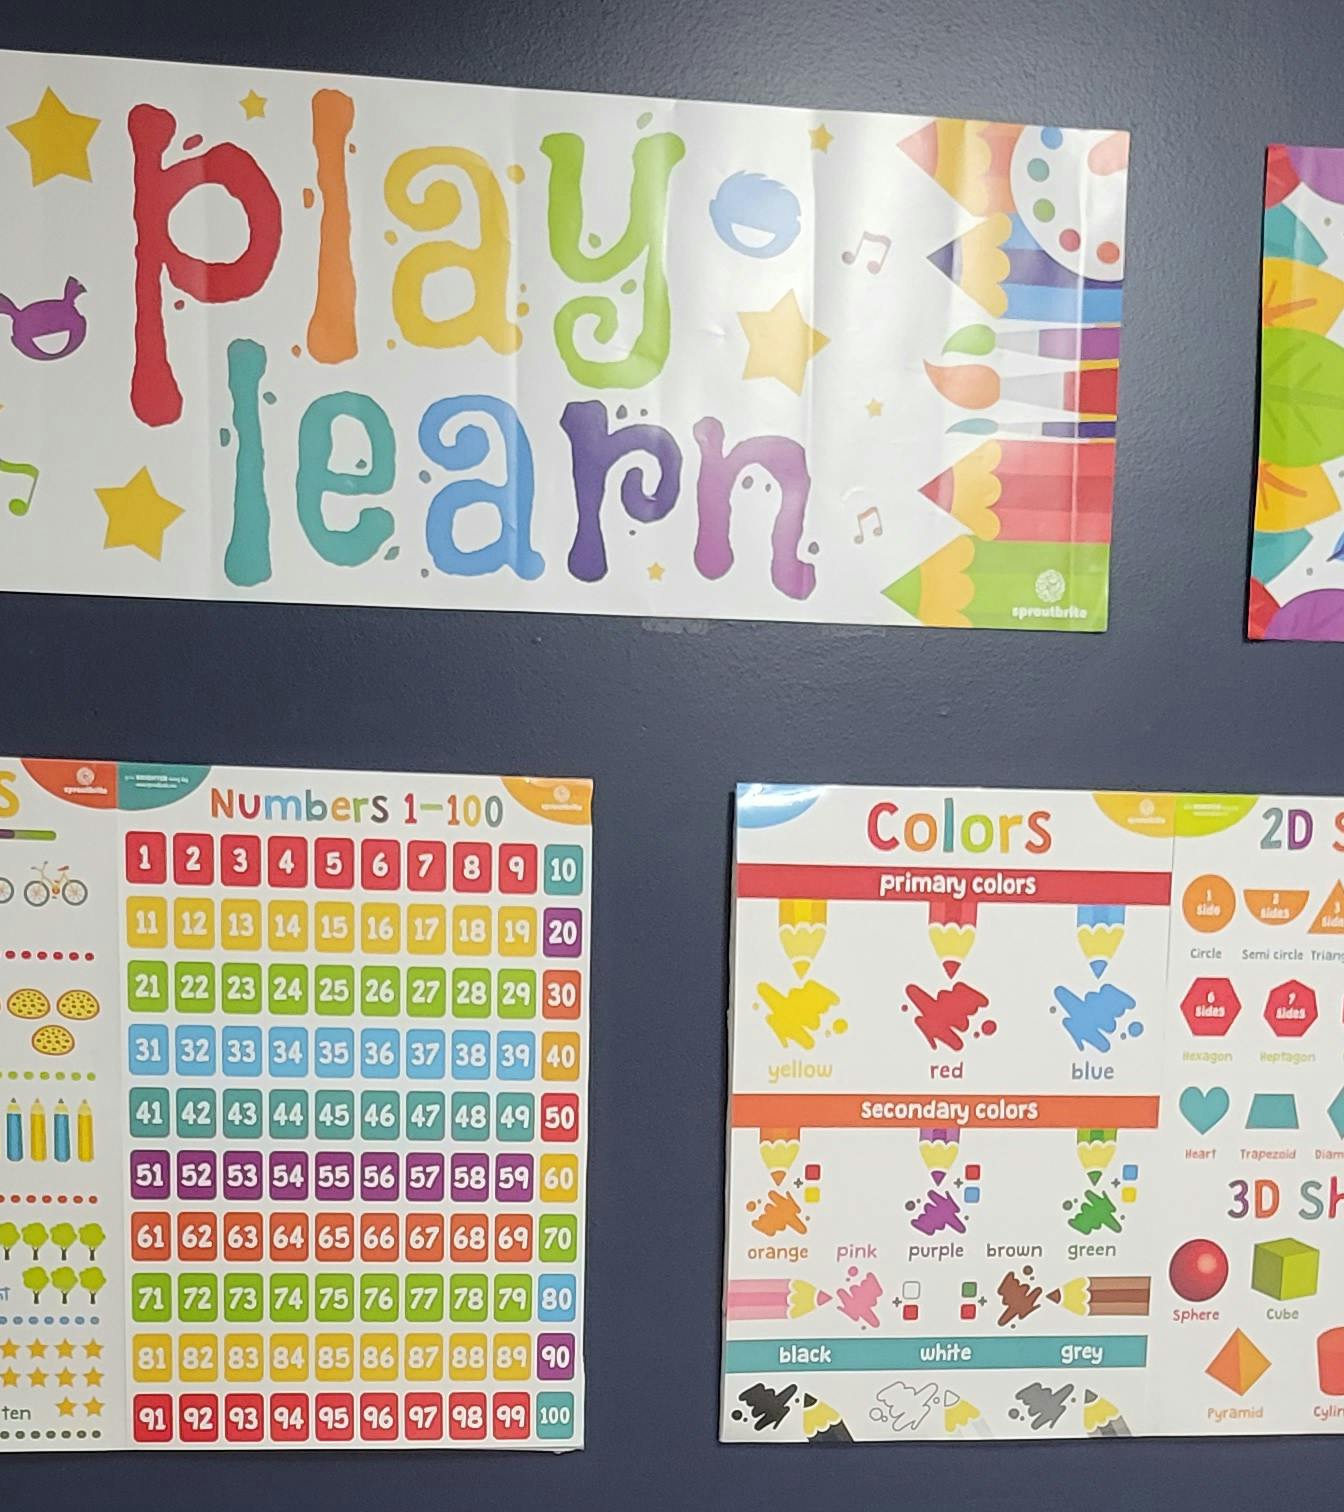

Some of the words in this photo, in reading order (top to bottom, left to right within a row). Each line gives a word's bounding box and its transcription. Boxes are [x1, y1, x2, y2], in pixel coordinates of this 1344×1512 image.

[127, 87, 685, 425] play
[223, 338, 816, 600] learn
[211, 788, 389, 823] Numbers
[404, 793, 503, 827] 1-100
[868, 798, 1051, 854] Colors
[1261, 808, 1313, 850] 2D
[140, 845, 150, 869] 1
[187, 846, 200, 870] 2
[233, 848, 247, 872] 3
[279, 850, 294, 873] 4
[326, 852, 342, 874] 5
[373, 853, 388, 877] 6
[419, 854, 434, 877] 7
[464, 855, 480, 879] 8
[509, 856, 525, 880] 9
[552, 858, 577, 881] 10
[879, 873, 966, 899] primary
[973, 873, 1035, 894] colors
[1191, 948, 1222, 959] Circle
[1242, 949, 1269, 959] Semi
[1273, 949, 1303, 960] circle
[768, 1060, 832, 1085] yellow
[931, 1062, 963, 1079] red
[1072, 1061, 1114, 1080] blue
[862, 1100, 969, 1124] secondary
[976, 1099, 1037, 1120] colors
[1186, 1149, 1216, 1159] Heart
[1240, 1149, 1296, 1161] Trapezoid
[1228, 1180, 1279, 1218] 3D
[748, 1247, 808, 1262] orange
[837, 1244, 877, 1262] pink
[909, 1243, 963, 1261] purple
[987, 1243, 1042, 1257] brown
[1068, 1245, 1116, 1260] green
[1173, 1308, 1220, 1322] Sphere
[1266, 1308, 1300, 1320] Cube
[779, 1345, 832, 1364] black
[921, 1343, 972, 1361] white
[1062, 1345, 1102, 1366] grey
[2, 1406, 31, 1420] ten
[140, 1408, 166, 1430] 91
[184, 1407, 212, 1429] 92
[230, 1408, 258, 1429] 93
[274, 1407, 304, 1429] 94
[319, 1407, 348, 1429] 95
[364, 1407, 393, 1428] 96
[409, 1406, 437, 1428] 97
[453, 1406, 482, 1428] 98
[497, 1406, 525, 1427] 99
[541, 1407, 570, 1424] 100
[1207, 1407, 1264, 1422] Pyramid
